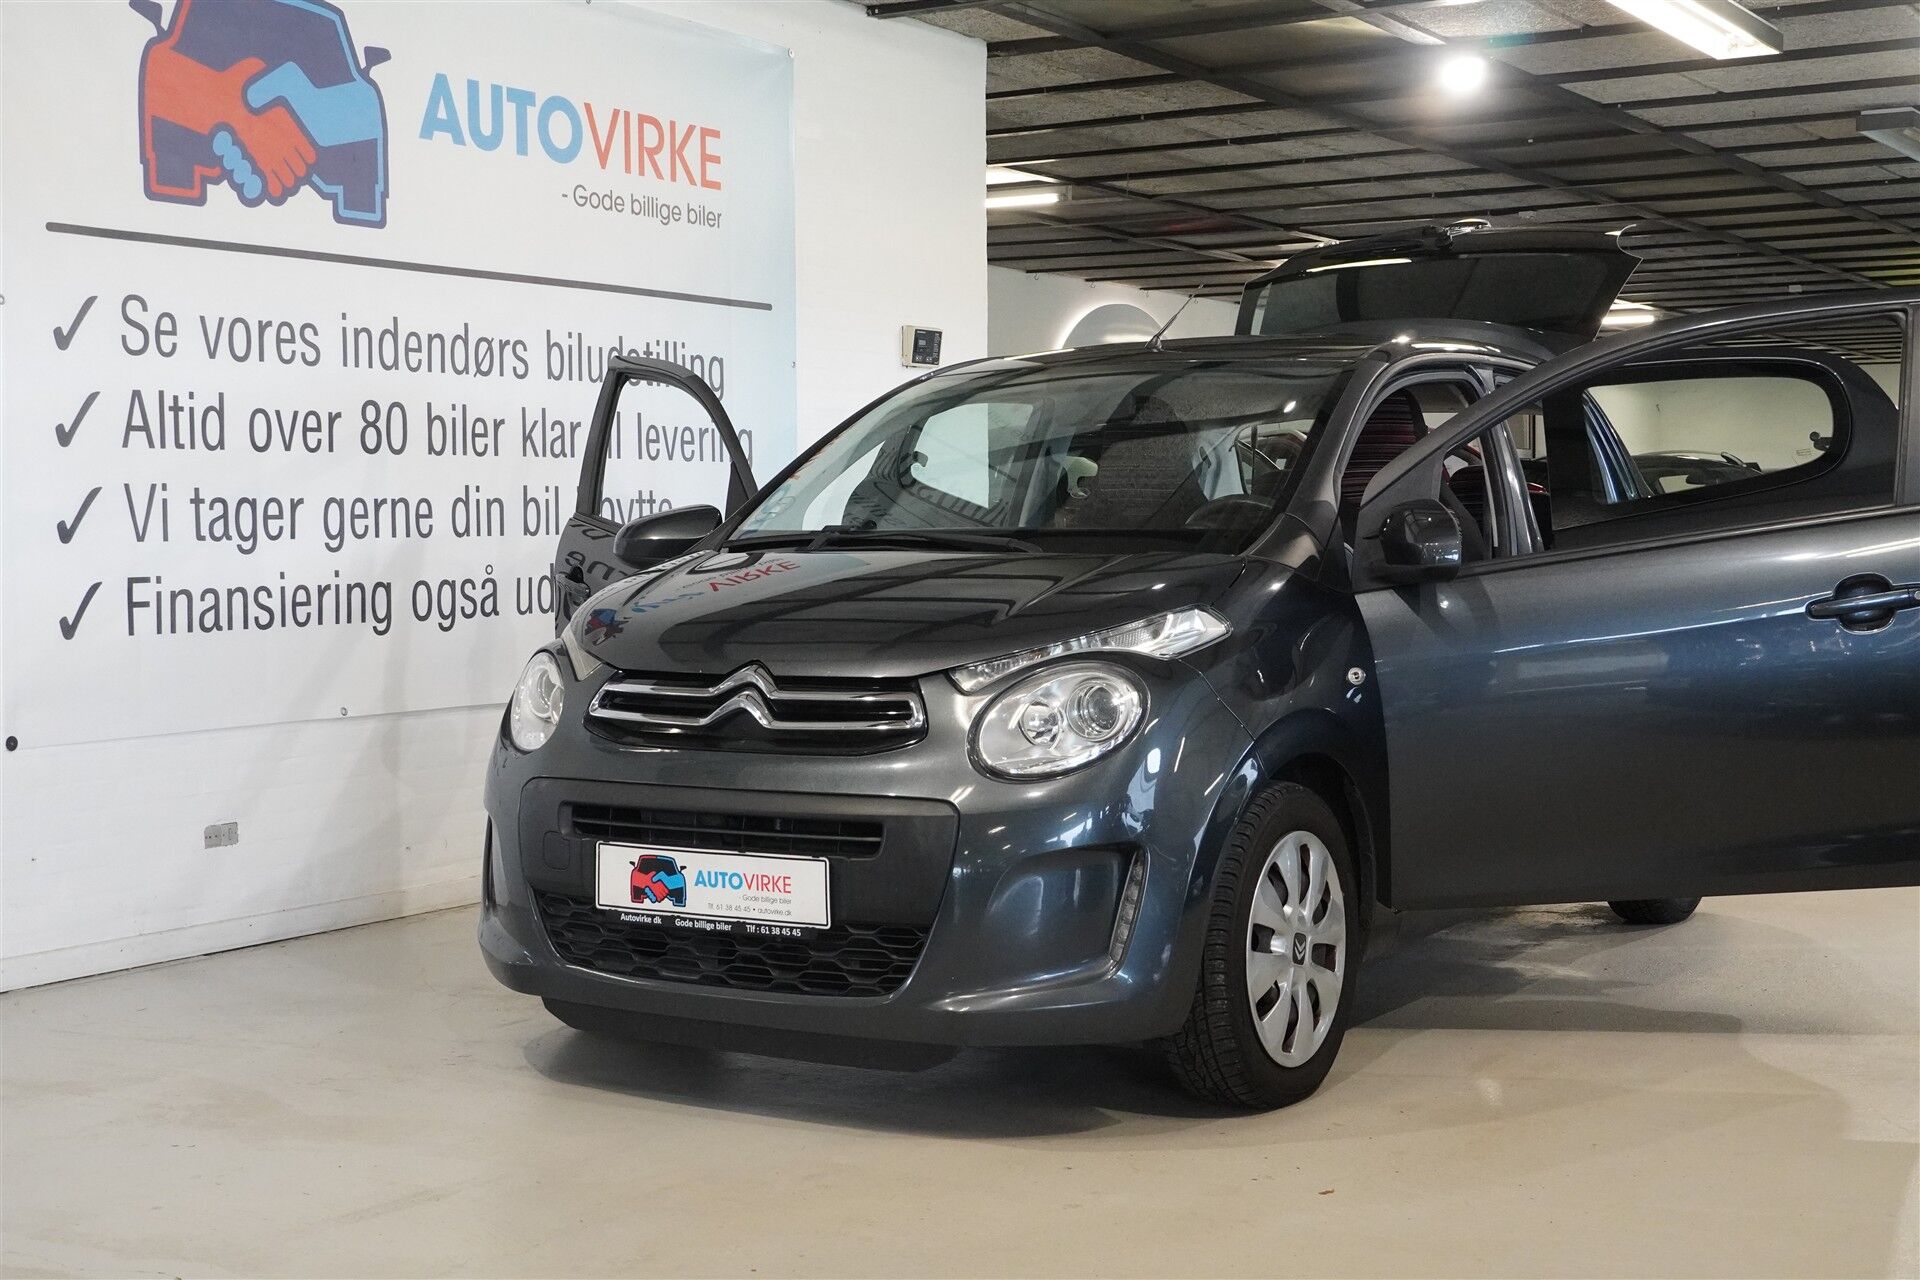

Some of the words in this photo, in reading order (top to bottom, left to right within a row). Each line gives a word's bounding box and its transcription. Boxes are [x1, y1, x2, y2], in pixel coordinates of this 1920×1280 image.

[420, 73, 722, 191] AUTOVIRKE
[573, 184, 625, 213] Gode
[630, 193, 682, 226] billige
[687, 203, 722, 229] biler
[121, 294, 178, 360] Se
[199, 312, 321, 367] vores
[342, 312, 530, 380] indendørs
[121, 390, 226, 452] Altid
[249, 402, 342, 454] over
[360, 400, 407, 456] 80
[426, 402, 505, 458] biler
[521, 407, 582, 459] klar
[124, 483, 169, 544] Vi
[190, 487, 304, 556] tager
[323, 497, 434, 555] gerne
[452, 485, 505, 540] din
[522, 485, 560, 536] bil
[126, 570, 393, 638] Finansiering
[411, 564, 499, 634] også
[694, 870, 792, 894] AUTOVIRKE
[620, 913, 652, 924] Autovirke
[653, 916, 662, 924] dk
[675, 918, 693, 927] Gode
[694, 920, 714, 930] billige
[716, 922, 732, 931] biler
[746, 924, 755, 933] Tlf
[760, 926, 770, 934] 61
[771, 927, 780, 935] 38
[781, 928, 791, 936] 45
[792, 928, 801, 937] 45
